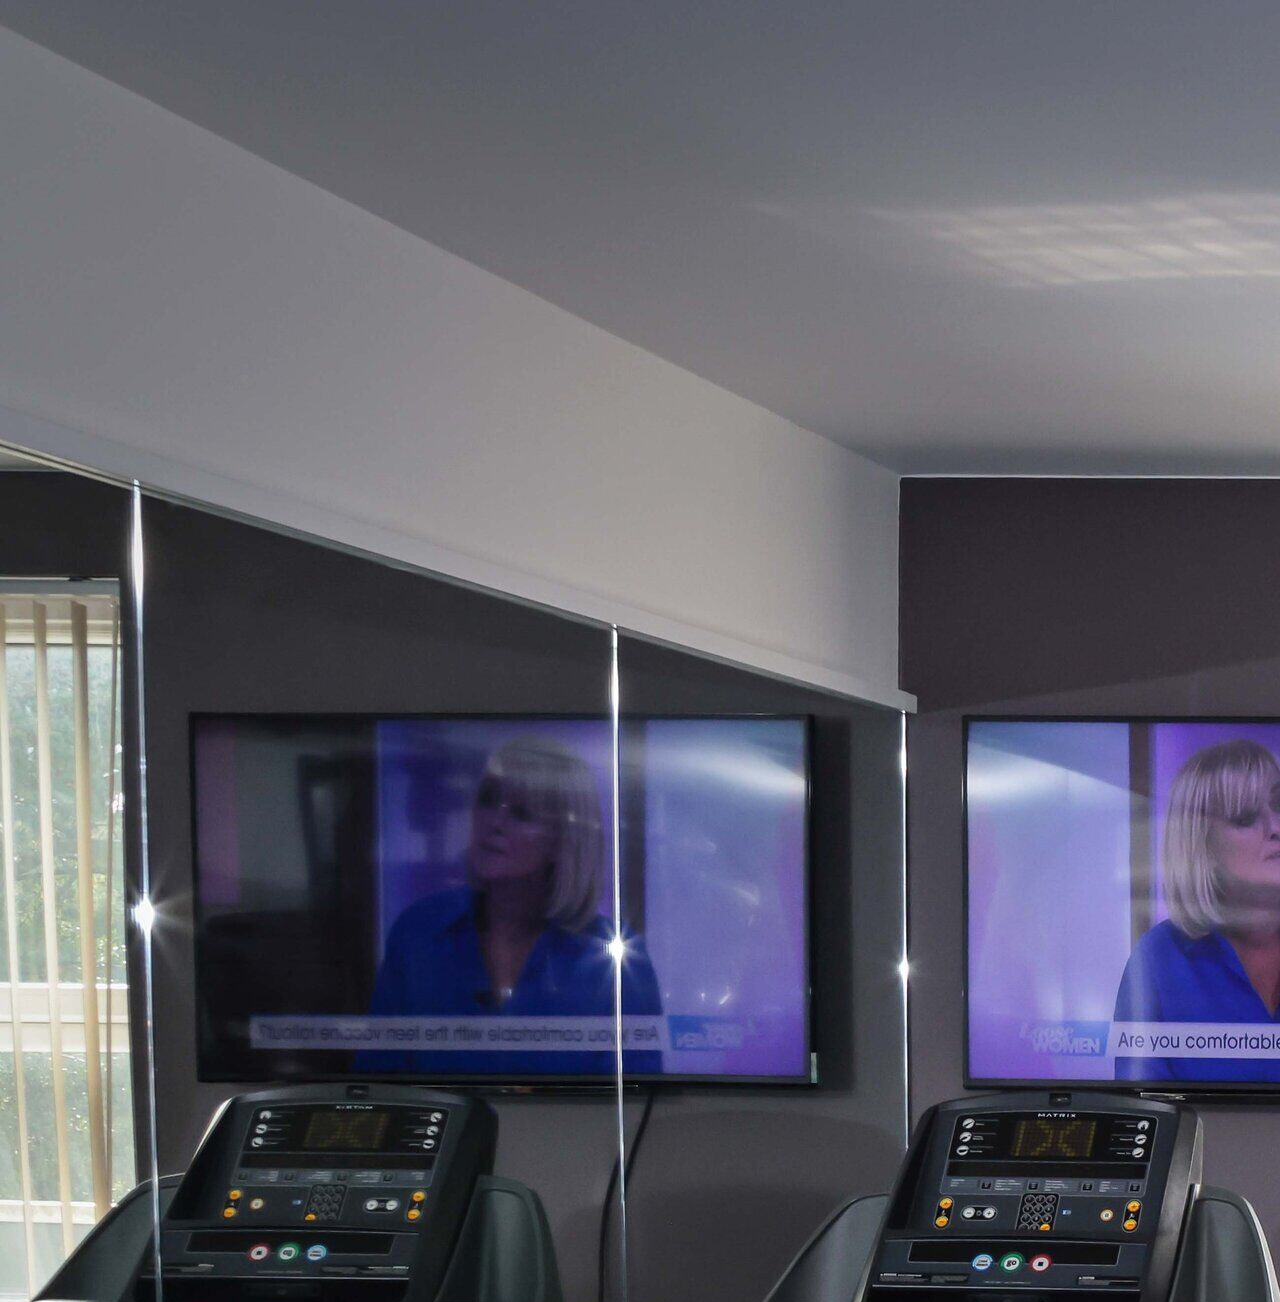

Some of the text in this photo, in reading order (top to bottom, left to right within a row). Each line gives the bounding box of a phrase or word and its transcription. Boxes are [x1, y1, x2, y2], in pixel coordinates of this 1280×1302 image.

[1117, 1031, 1145, 1049] Are
[1150, 1034, 1180, 1052] you
[1006, 1259, 1017, 1268] go
